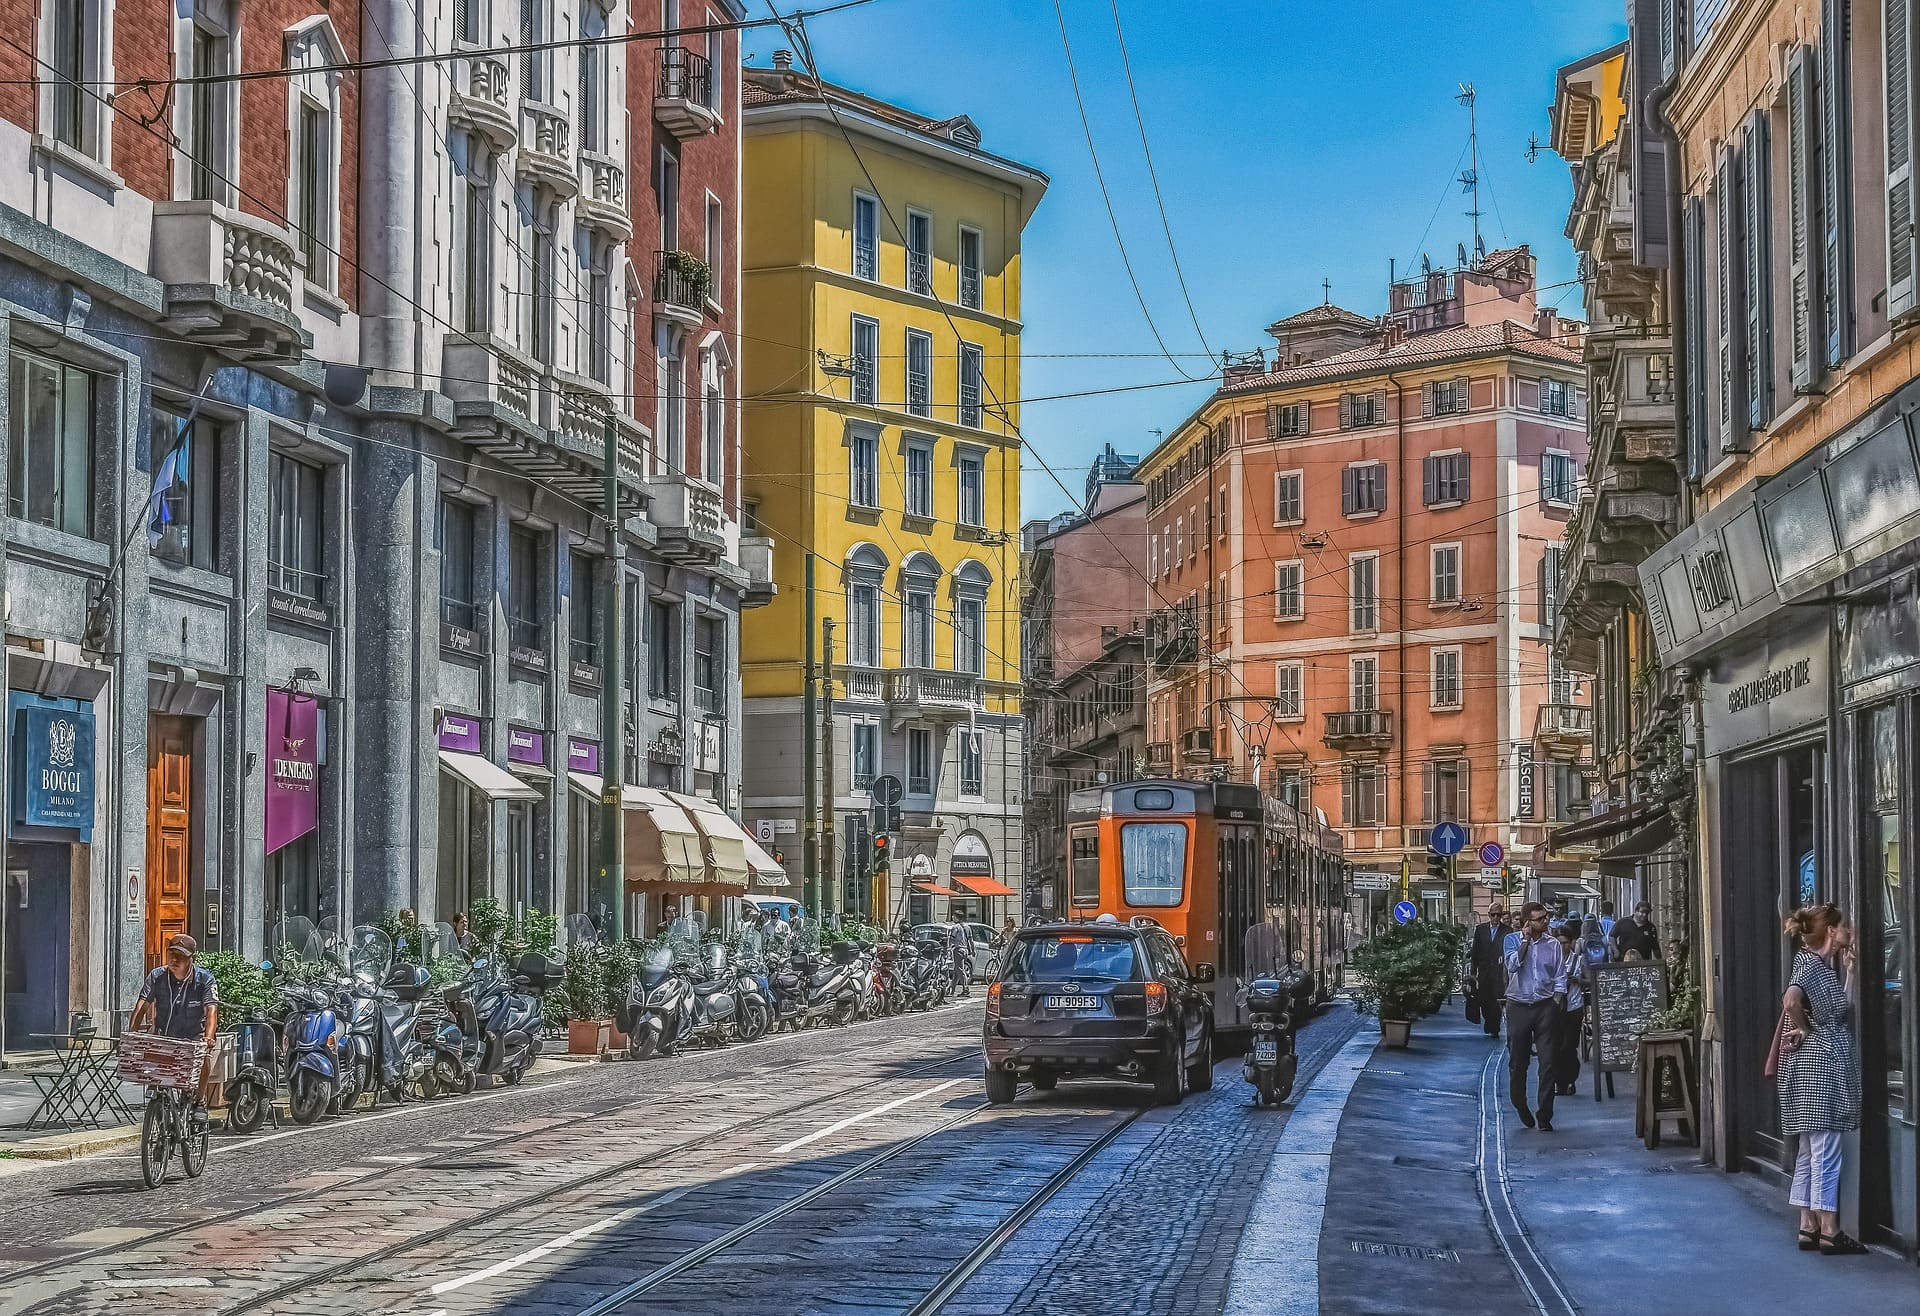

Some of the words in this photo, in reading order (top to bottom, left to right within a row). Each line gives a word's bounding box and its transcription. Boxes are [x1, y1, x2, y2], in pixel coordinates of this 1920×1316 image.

[1728, 682, 1749, 714] GREAT
[1750, 670, 1782, 706] MASTERS
[1782, 664, 1794, 693] OF
[1793, 655, 1811, 689] TIME
[42, 769, 81, 793] BOGGI
[50, 795, 75, 806] MILANO
[1520, 749, 1532, 815] TASCHEN
